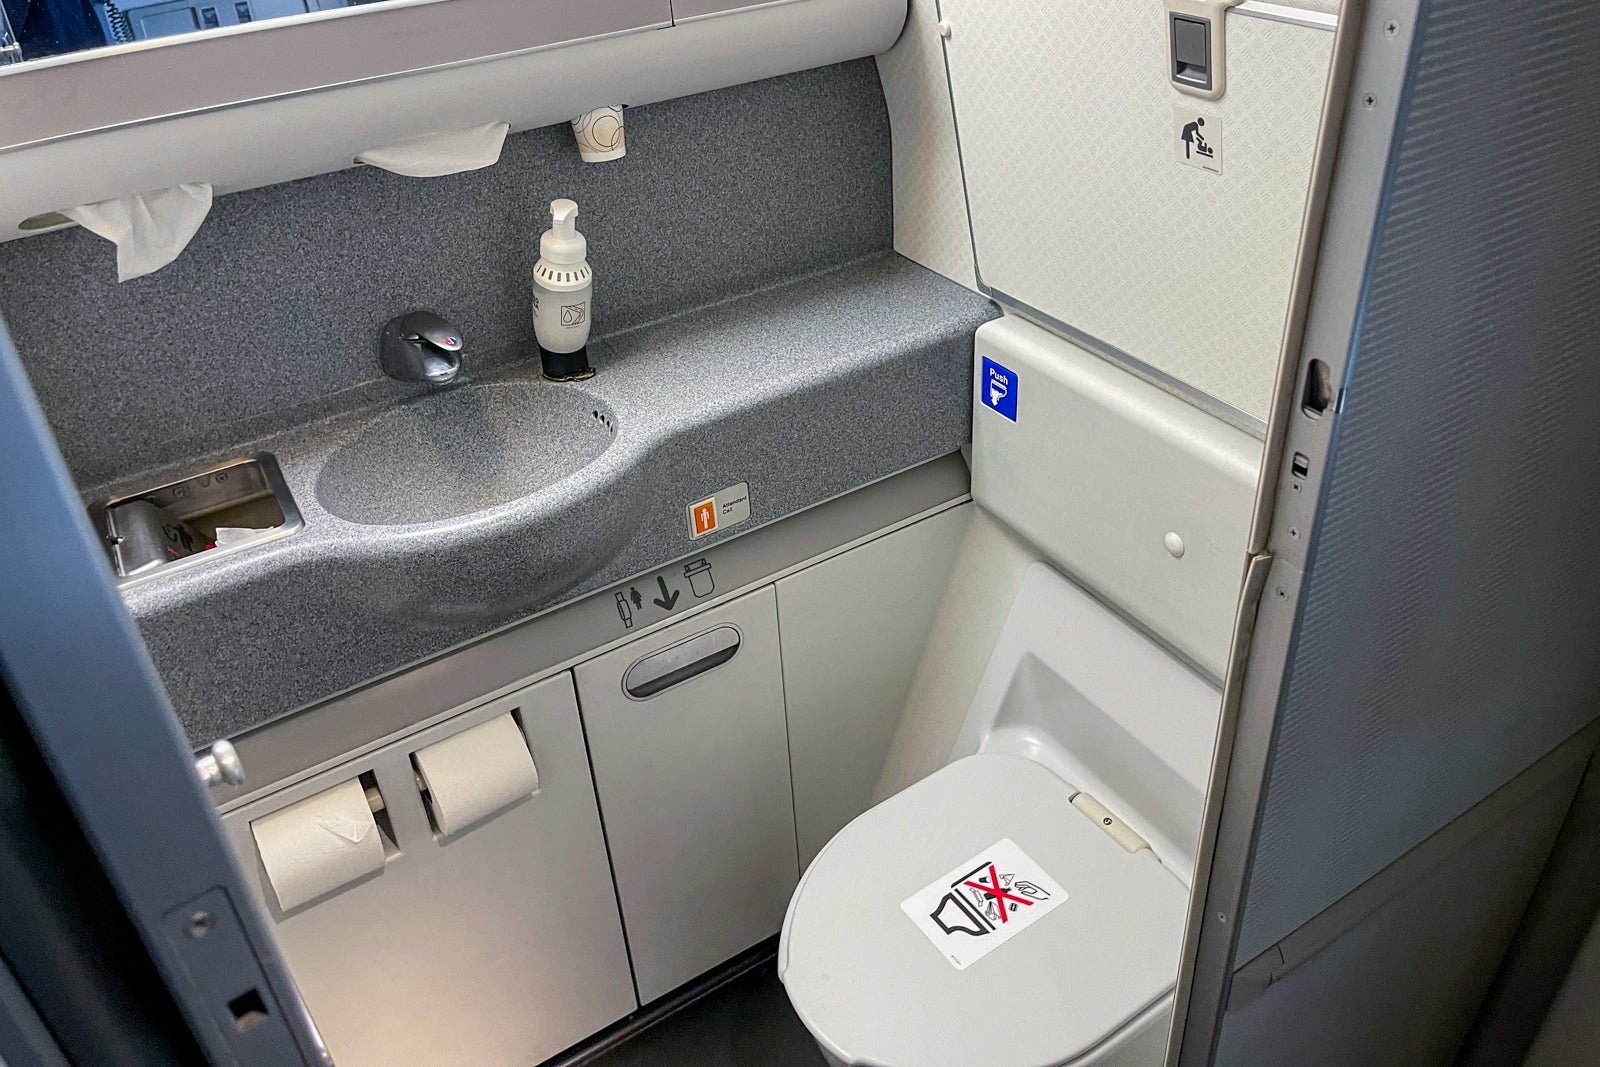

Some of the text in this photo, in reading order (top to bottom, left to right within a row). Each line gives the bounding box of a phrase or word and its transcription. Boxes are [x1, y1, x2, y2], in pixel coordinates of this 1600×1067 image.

[990, 367, 1008, 385] Push
[722, 495, 747, 508] Attendant
[722, 507, 733, 515] Call
